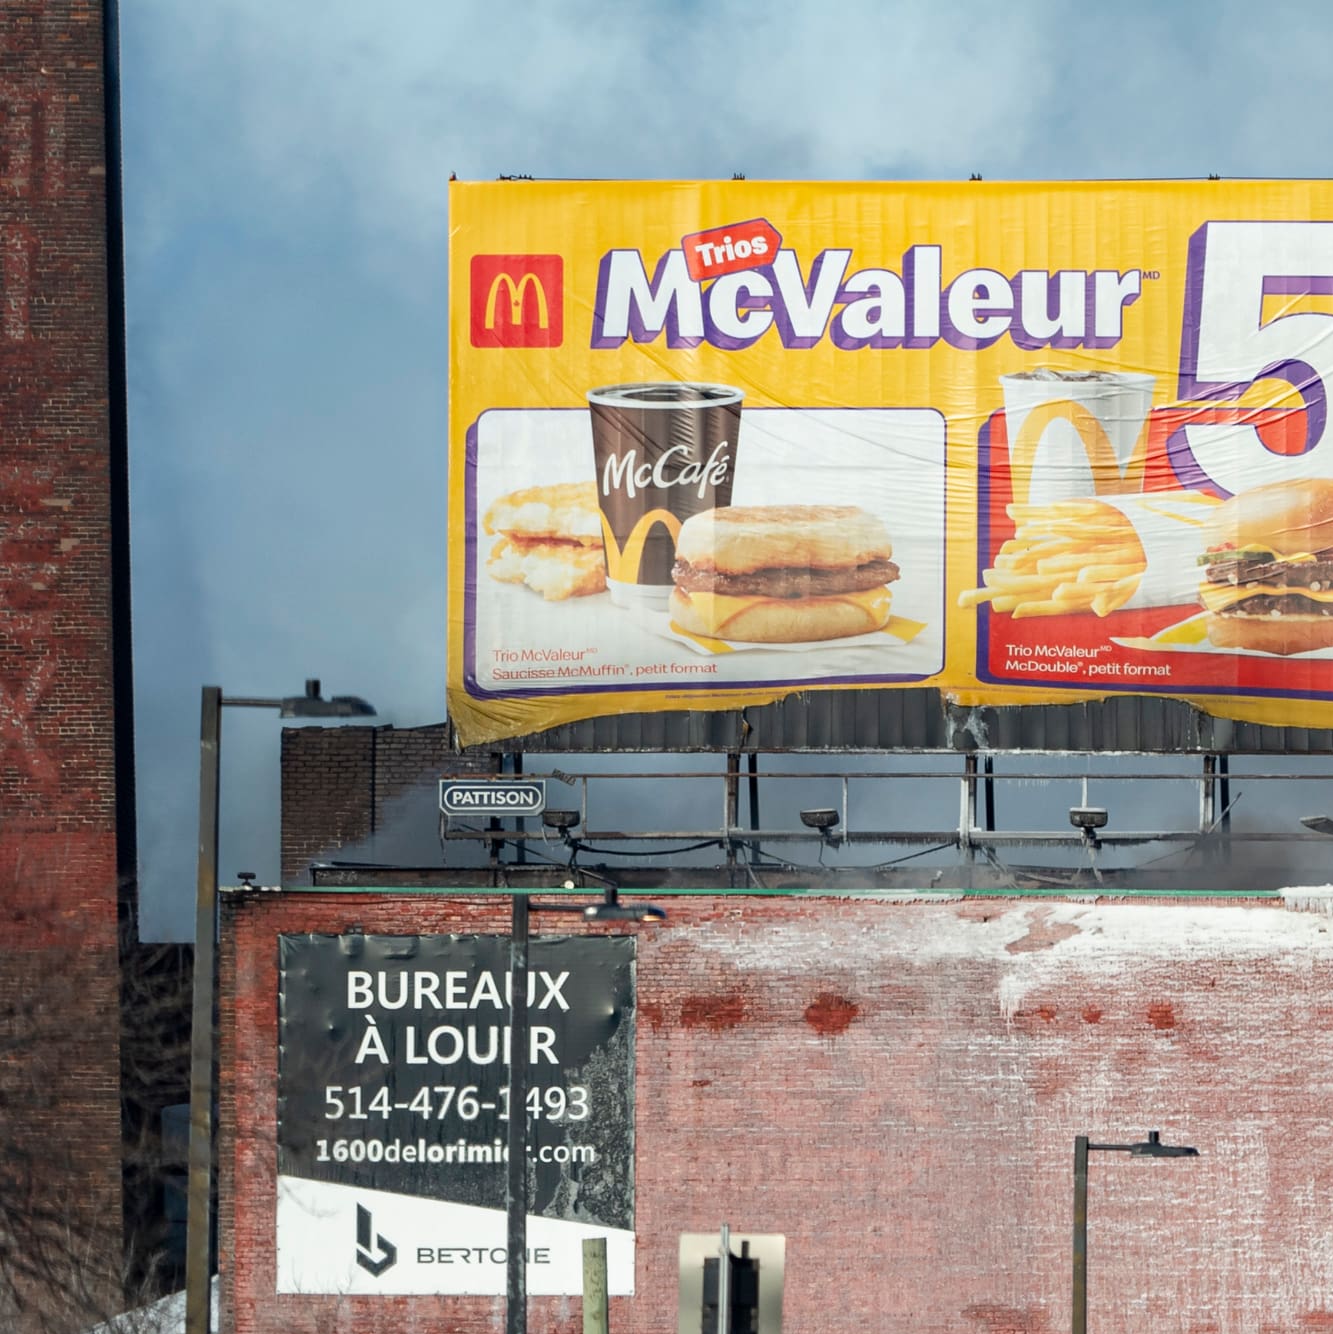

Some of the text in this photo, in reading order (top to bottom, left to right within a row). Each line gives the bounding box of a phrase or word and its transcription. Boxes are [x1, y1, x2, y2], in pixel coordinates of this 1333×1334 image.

[696, 233, 769, 268] Trios
[596, 245, 1141, 345] McValeur
[603, 441, 730, 499] McCafé
[494, 649, 518, 663] Trio
[521, 648, 585, 662] McValeur
[1005, 644, 1033, 658] Trio
[1034, 644, 1100, 659] McValeur
[492, 667, 556, 681] Saucisse
[636, 663, 668, 677] petit
[670, 662, 718, 675] format
[1088, 662, 1121, 677] petit
[1123, 663, 1172, 677] format
[452, 791, 534, 805] PATTISON
[354, 1014, 389, 1064] À
[316, 1138, 596, 1164] 1600delorimi.com
[416, 1247, 551, 1265] BERTOE
